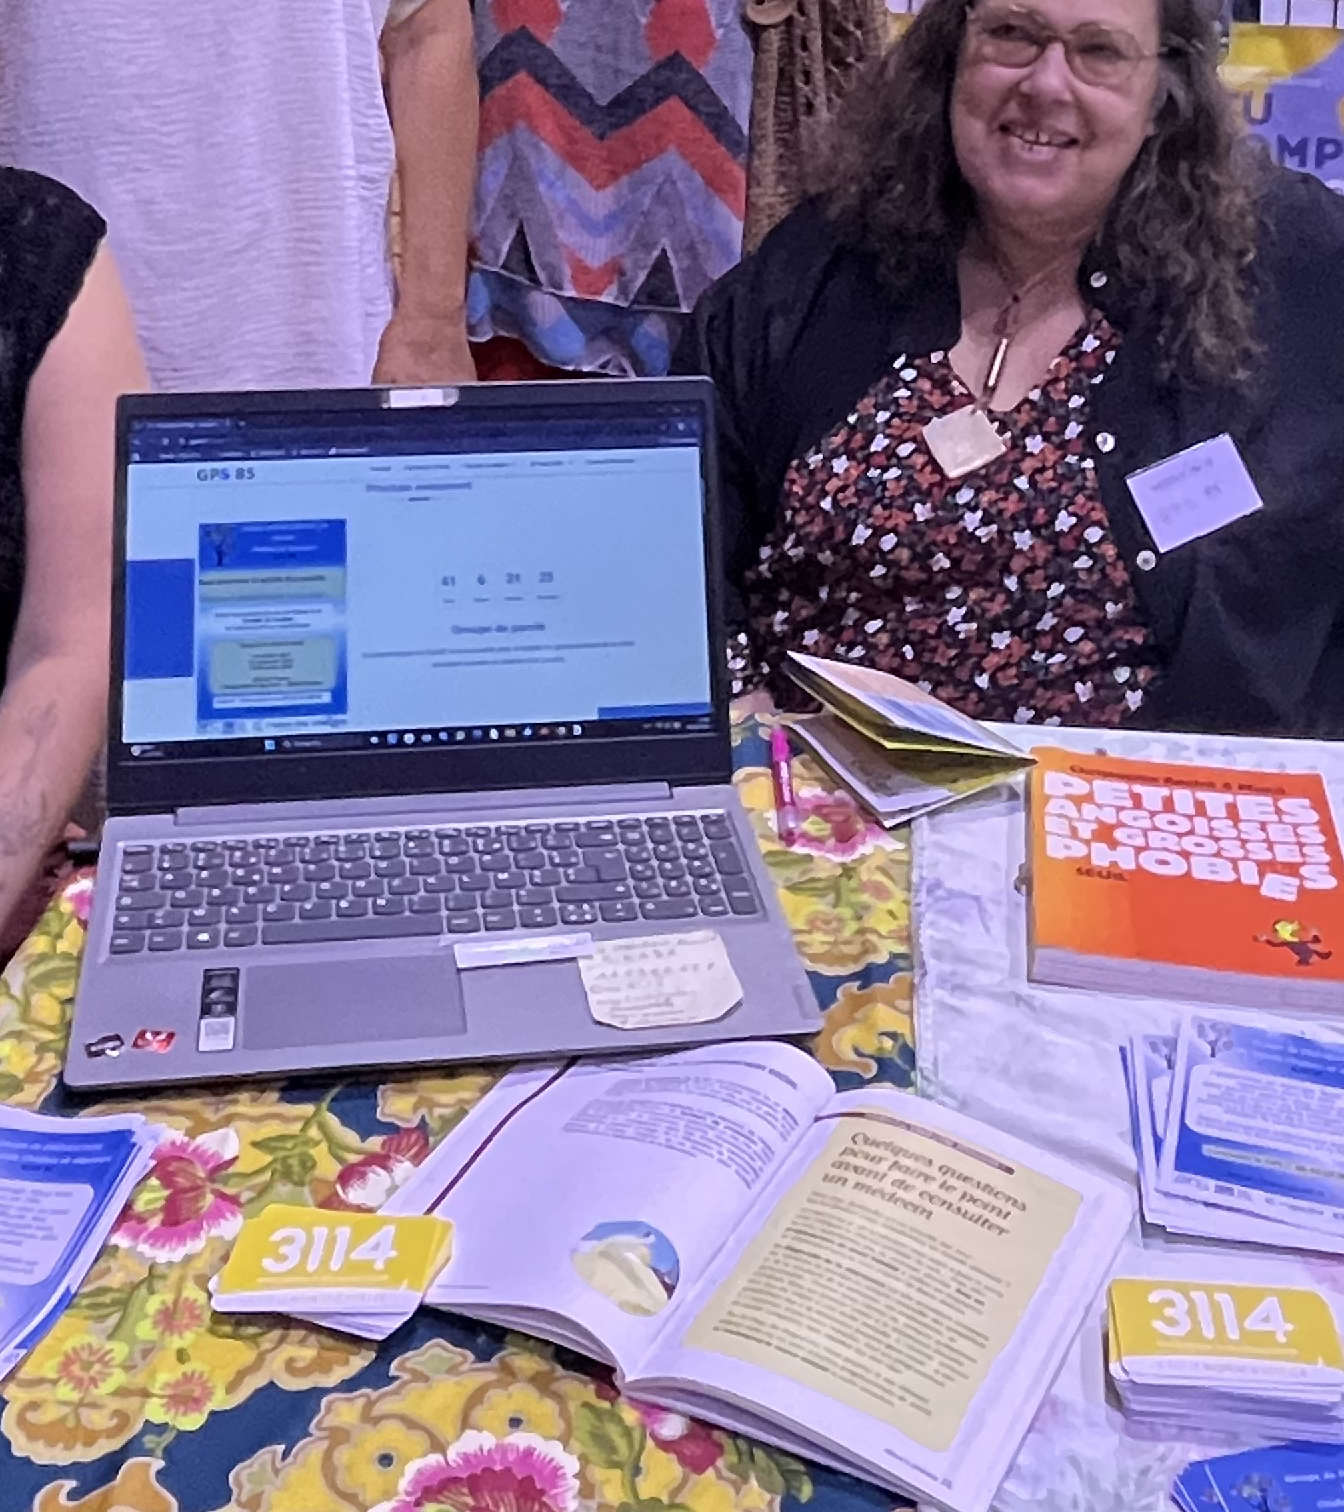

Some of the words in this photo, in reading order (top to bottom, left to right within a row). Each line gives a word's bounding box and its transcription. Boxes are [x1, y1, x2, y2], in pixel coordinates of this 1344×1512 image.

[196, 468, 230, 481] GPS
[235, 468, 256, 479] 85
[1044, 770, 1319, 824] PETITES
[1044, 798, 1326, 844] ANGOISSES
[1044, 814, 1098, 839] ET
[1113, 827, 1331, 863] GROSSES
[1046, 834, 1338, 902] PHOBIES
[822, 1173, 849, 1187] un
[830, 1160, 889, 1182] avant
[890, 1178, 916, 1193] de
[918, 1190, 1011, 1236] consulter
[937, 1164, 1027, 1212] questions
[959, 1190, 1012, 1220] point
[261, 1224, 398, 1273] 3114
[1147, 1288, 1295, 1344] 3114
